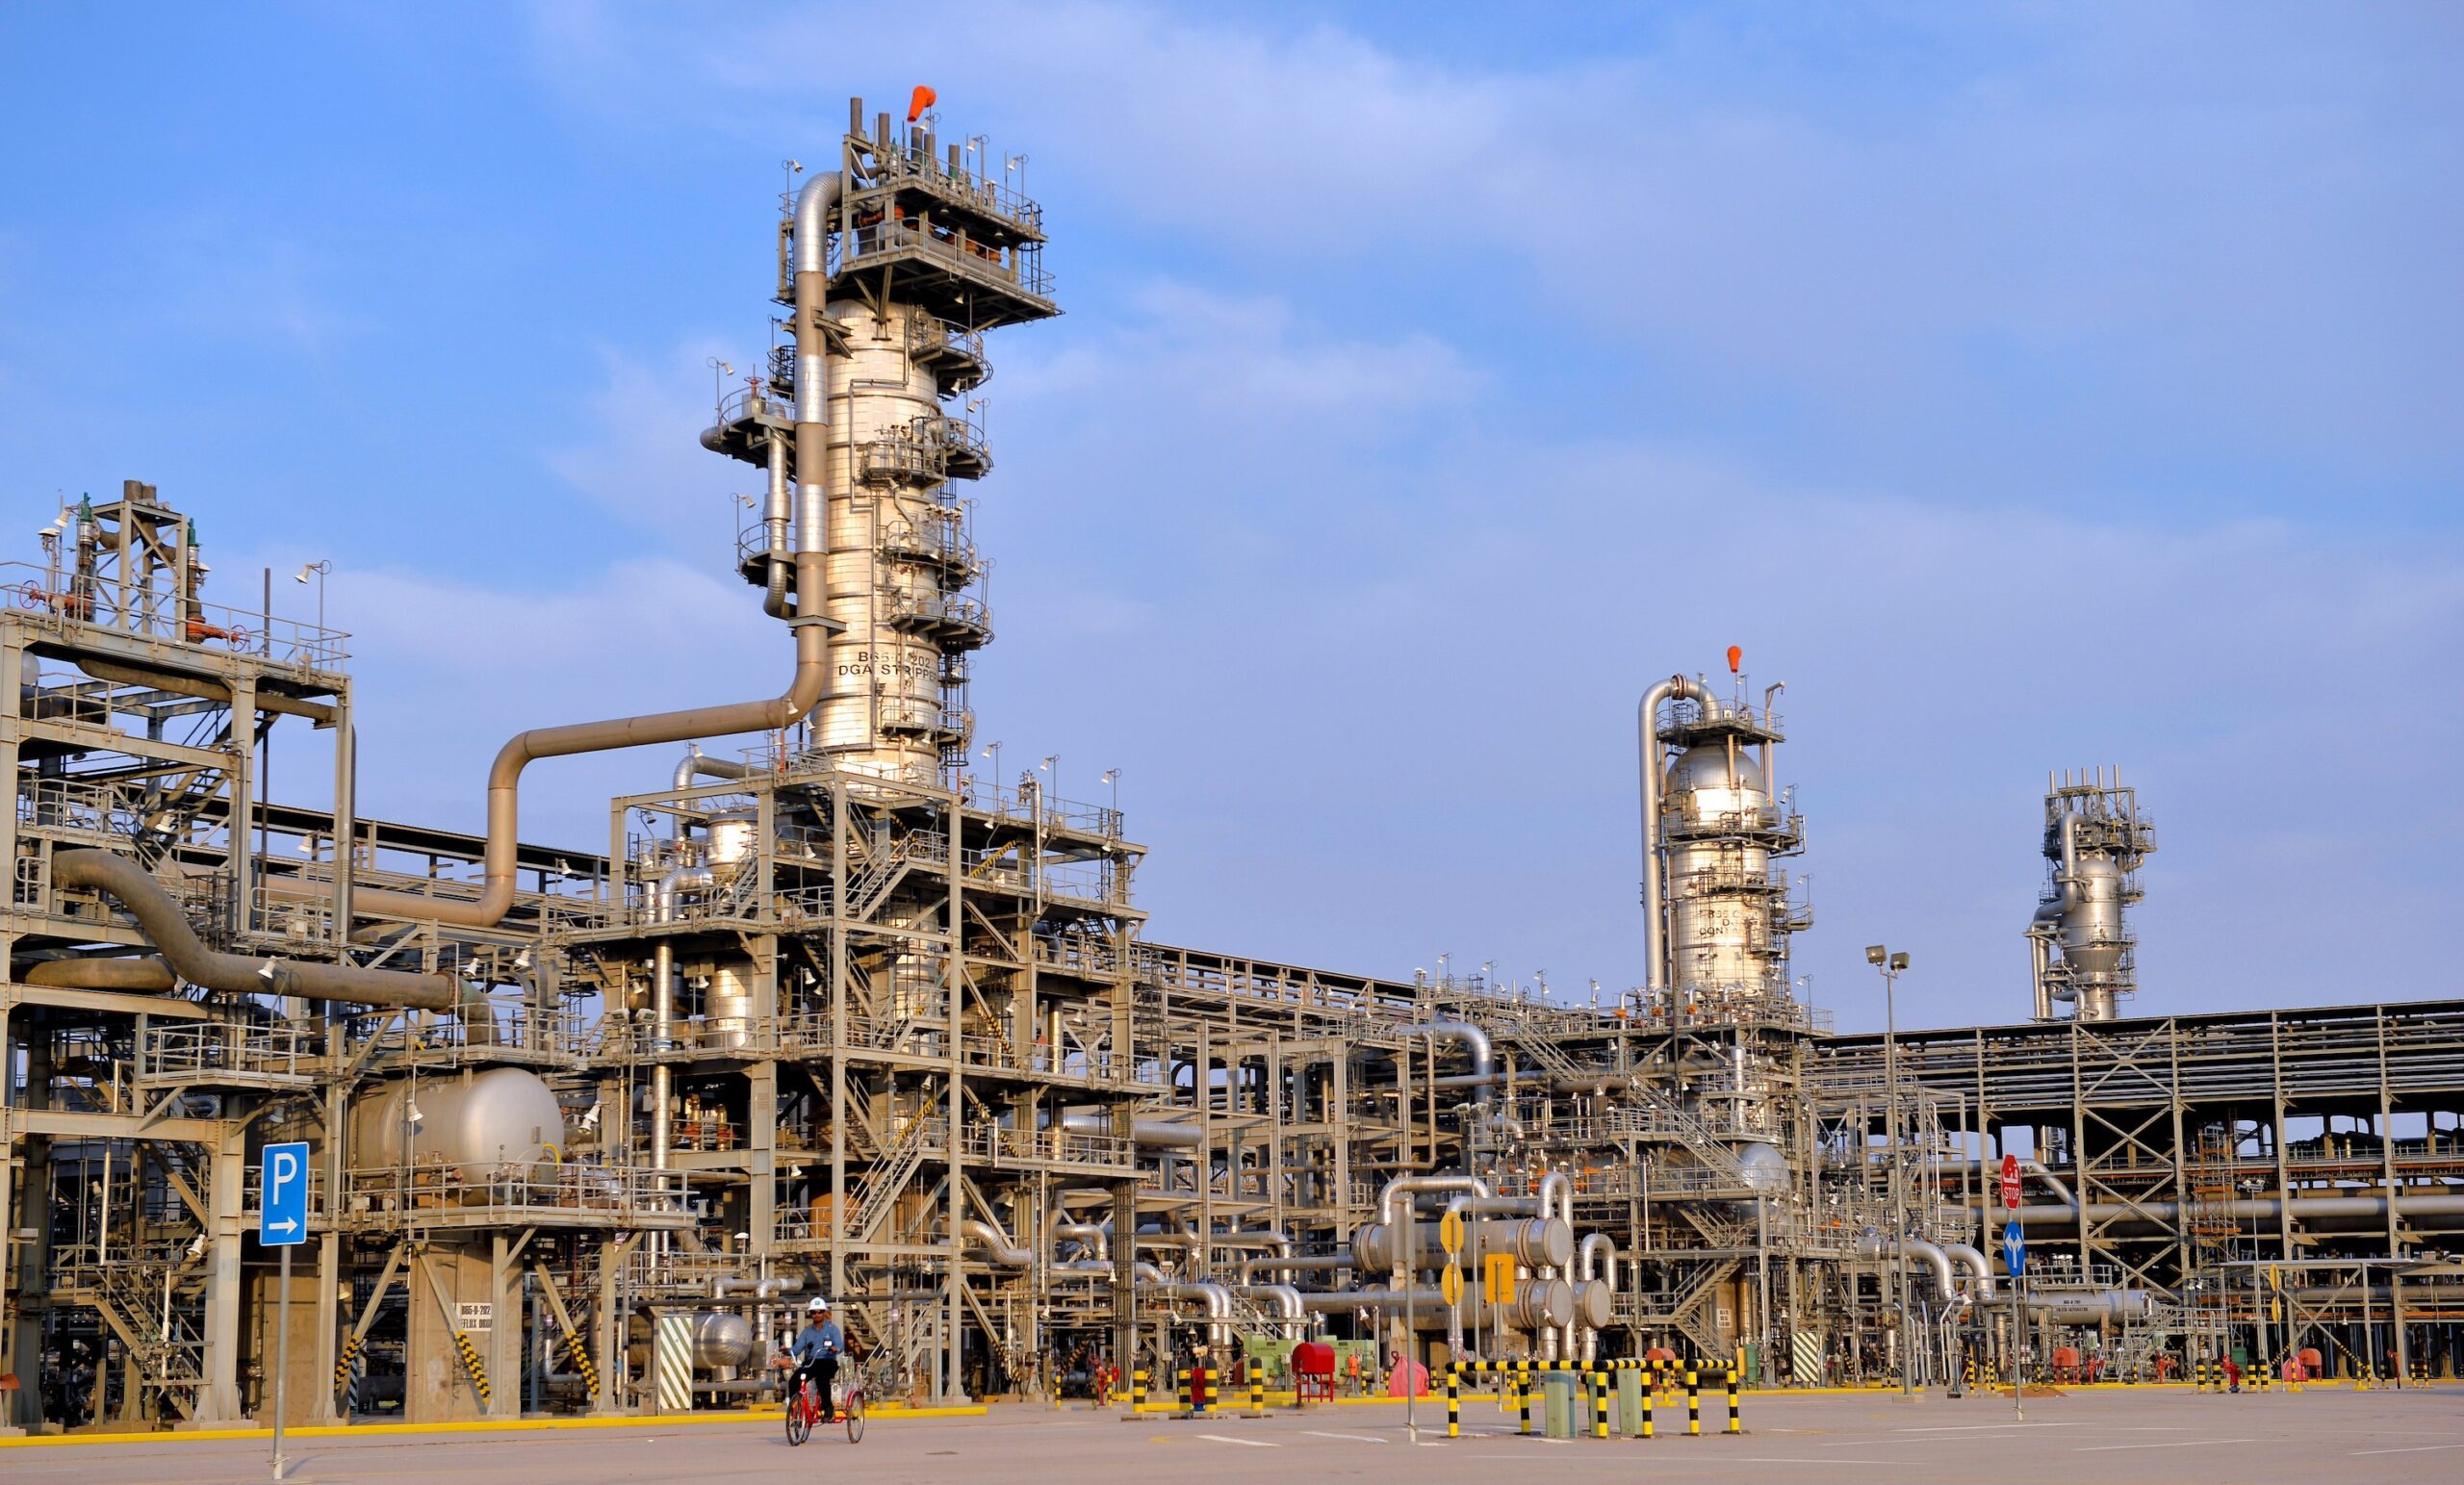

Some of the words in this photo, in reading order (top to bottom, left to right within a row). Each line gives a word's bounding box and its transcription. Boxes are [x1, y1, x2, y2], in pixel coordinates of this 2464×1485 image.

[838, 664, 872, 676] DGA
[273, 1152, 297, 1206] P
[2003, 1164, 2018, 1184] قف
[2004, 1187, 2019, 1200] STOP
